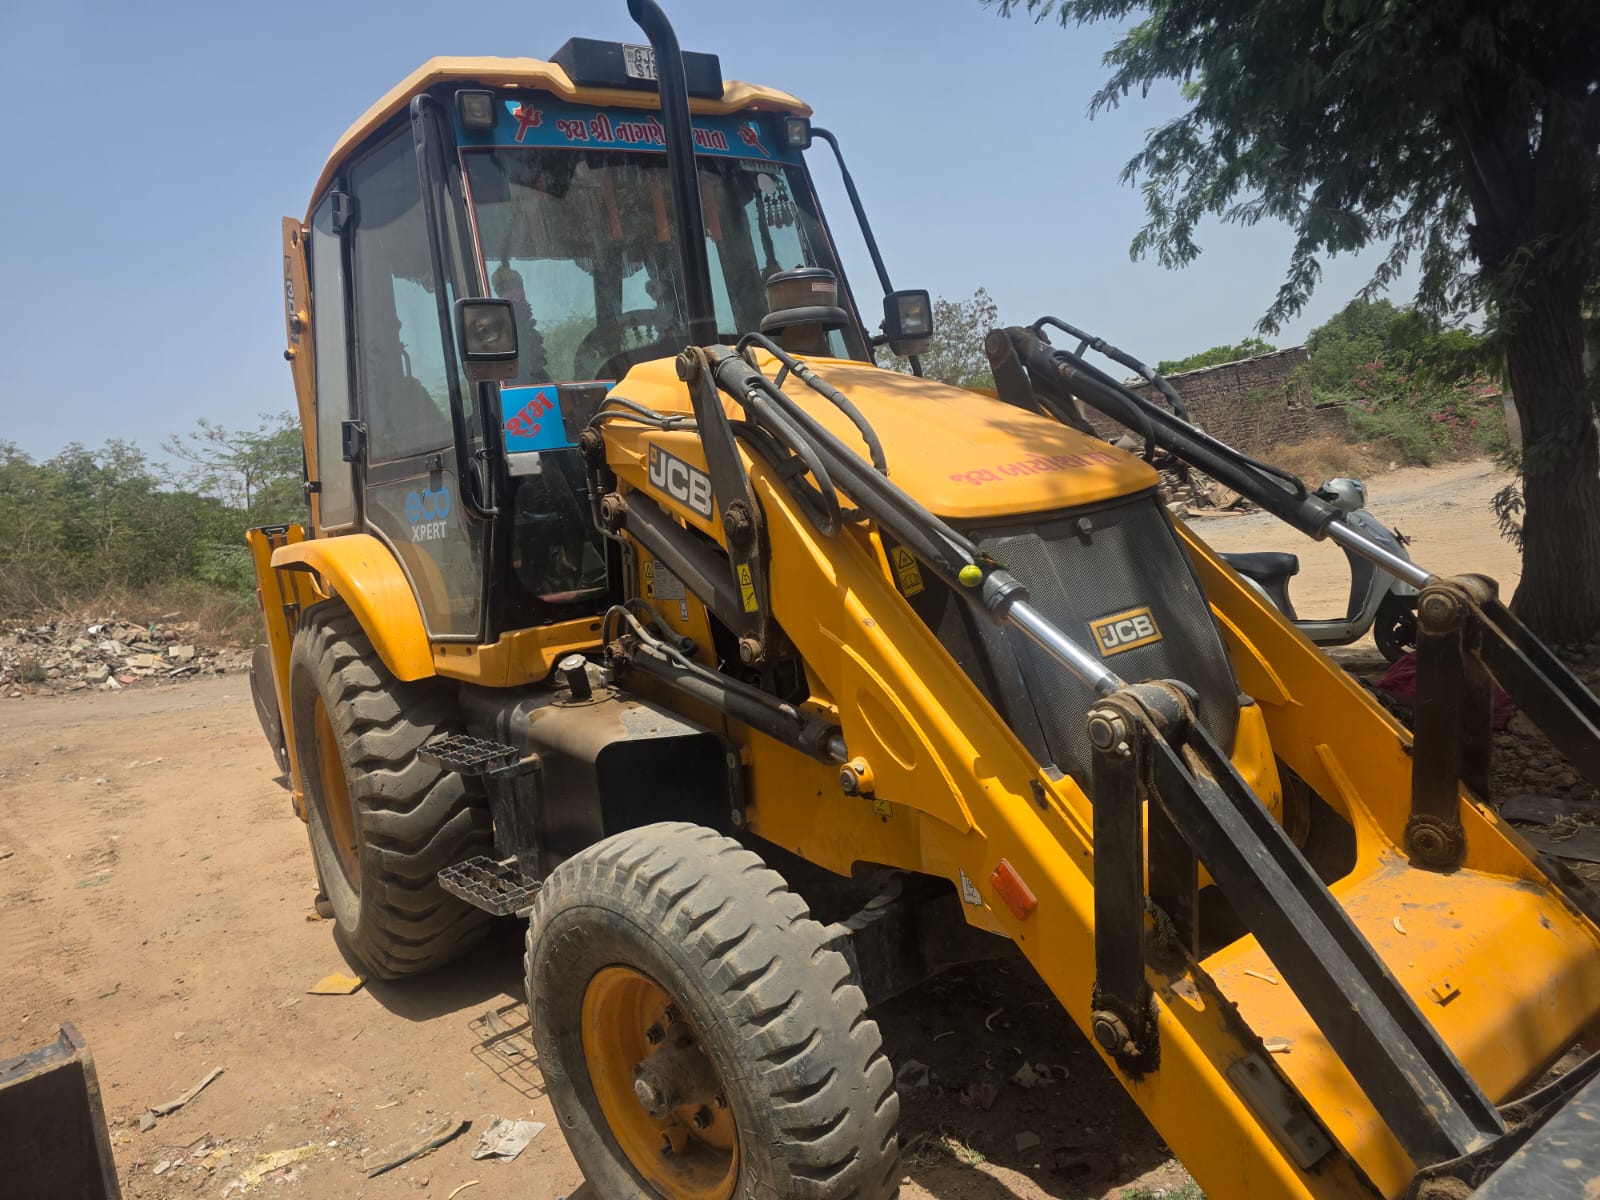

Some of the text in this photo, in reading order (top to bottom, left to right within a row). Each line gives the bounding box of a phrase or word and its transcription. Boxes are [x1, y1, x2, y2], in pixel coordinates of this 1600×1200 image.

[557, 119, 589, 140] જય
[590, 112, 614, 142] શ્રી
[650, 452, 712, 516] JCB
[949, 468, 1003, 486] જય
[406, 486, 451, 524] eco
[411, 521, 447, 542] XPERT
[1102, 615, 1155, 648] JCB
